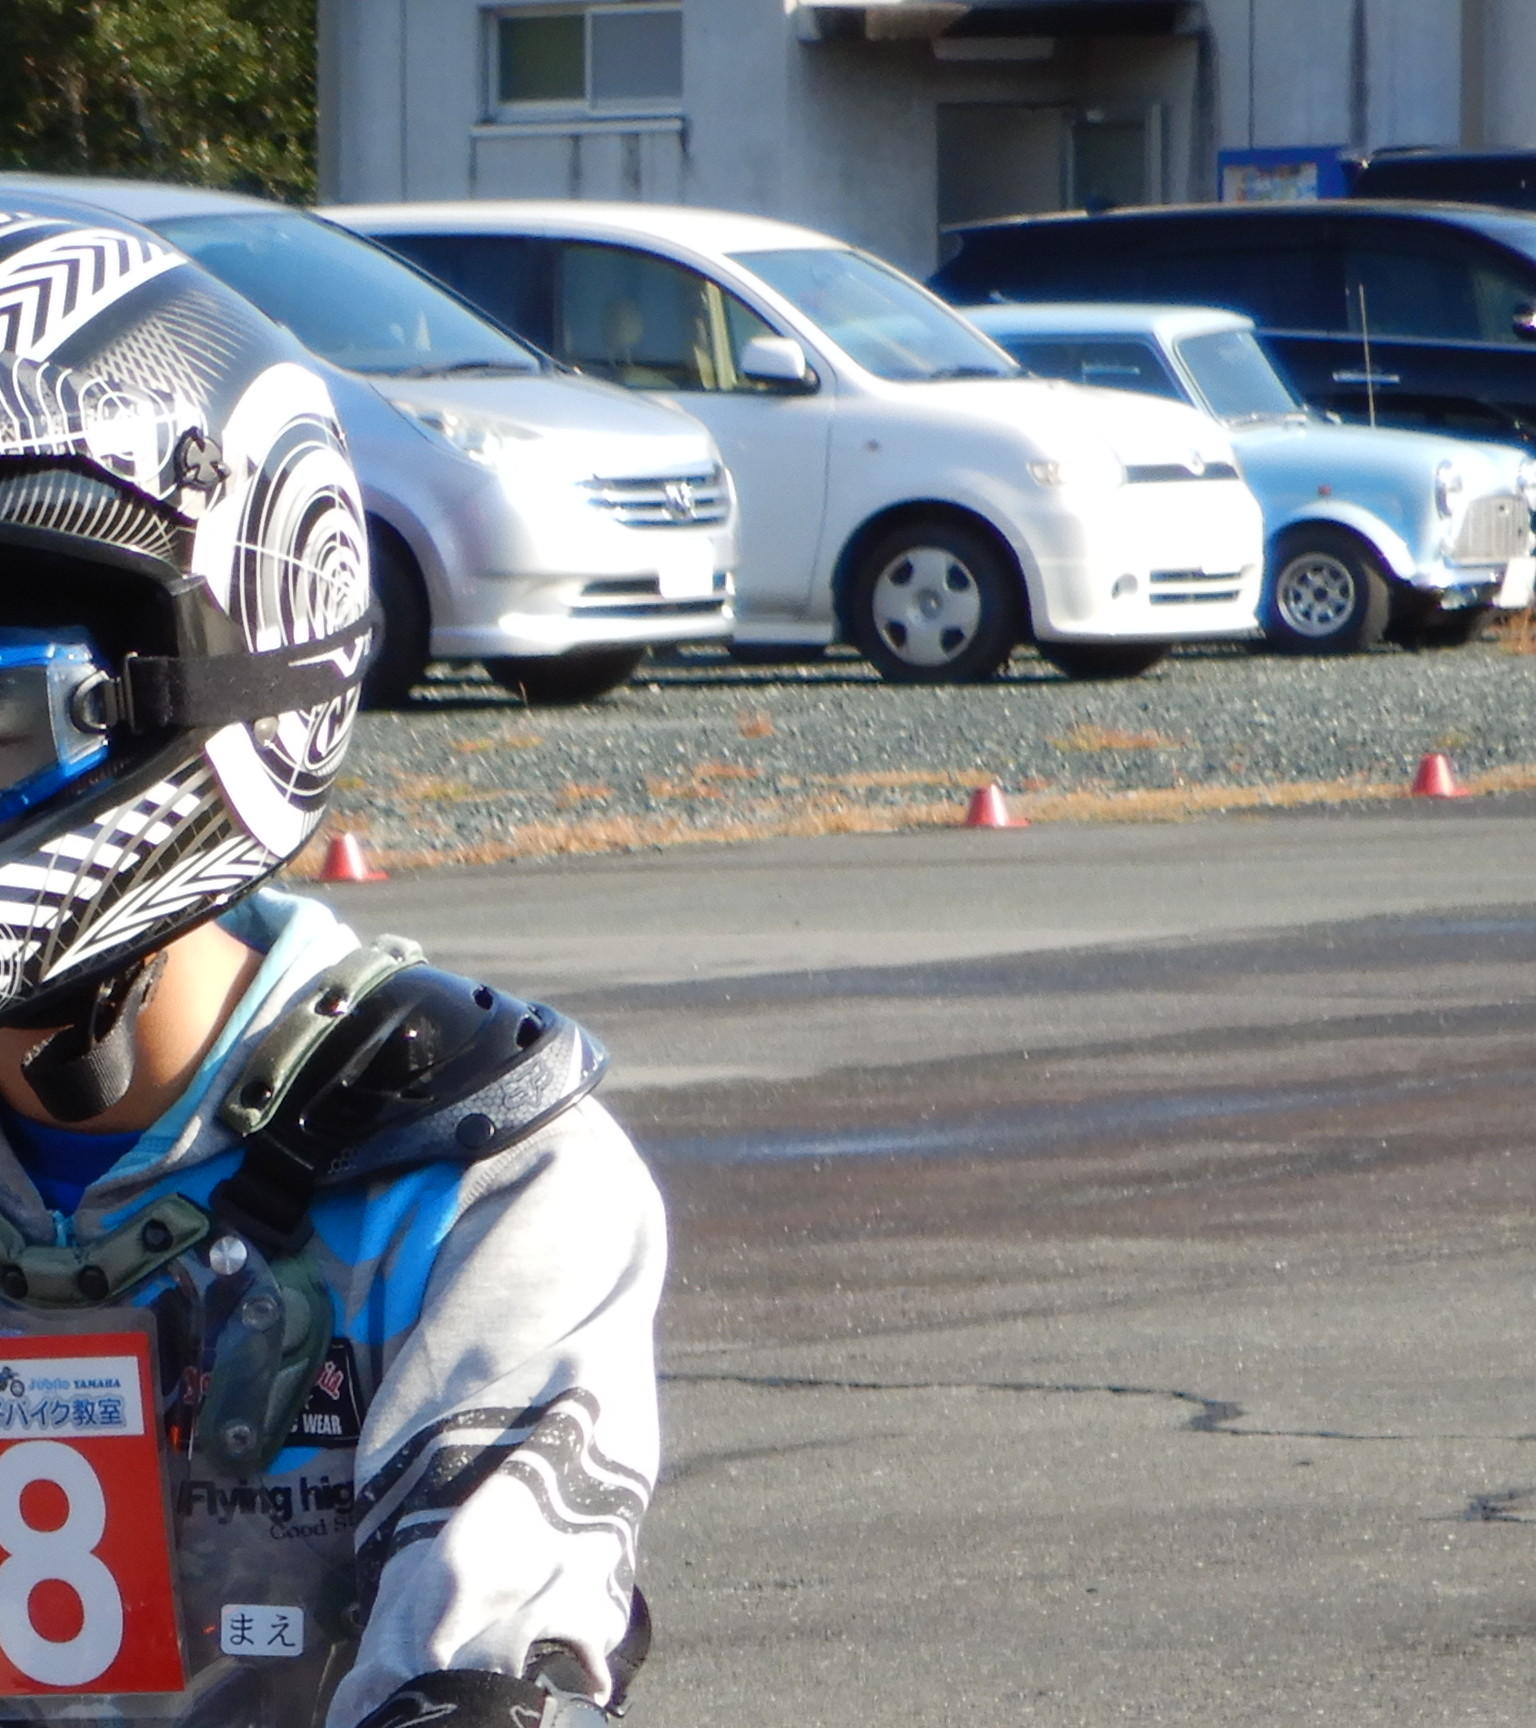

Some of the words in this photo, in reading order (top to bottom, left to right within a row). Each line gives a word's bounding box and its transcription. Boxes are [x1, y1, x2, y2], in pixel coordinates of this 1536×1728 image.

[73, 1378, 121, 1390] YAMAHA
[303, 1413, 343, 1435] WEAR
[177, 1479, 293, 1524] Flying
[230, 1613, 296, 1647] まえ
